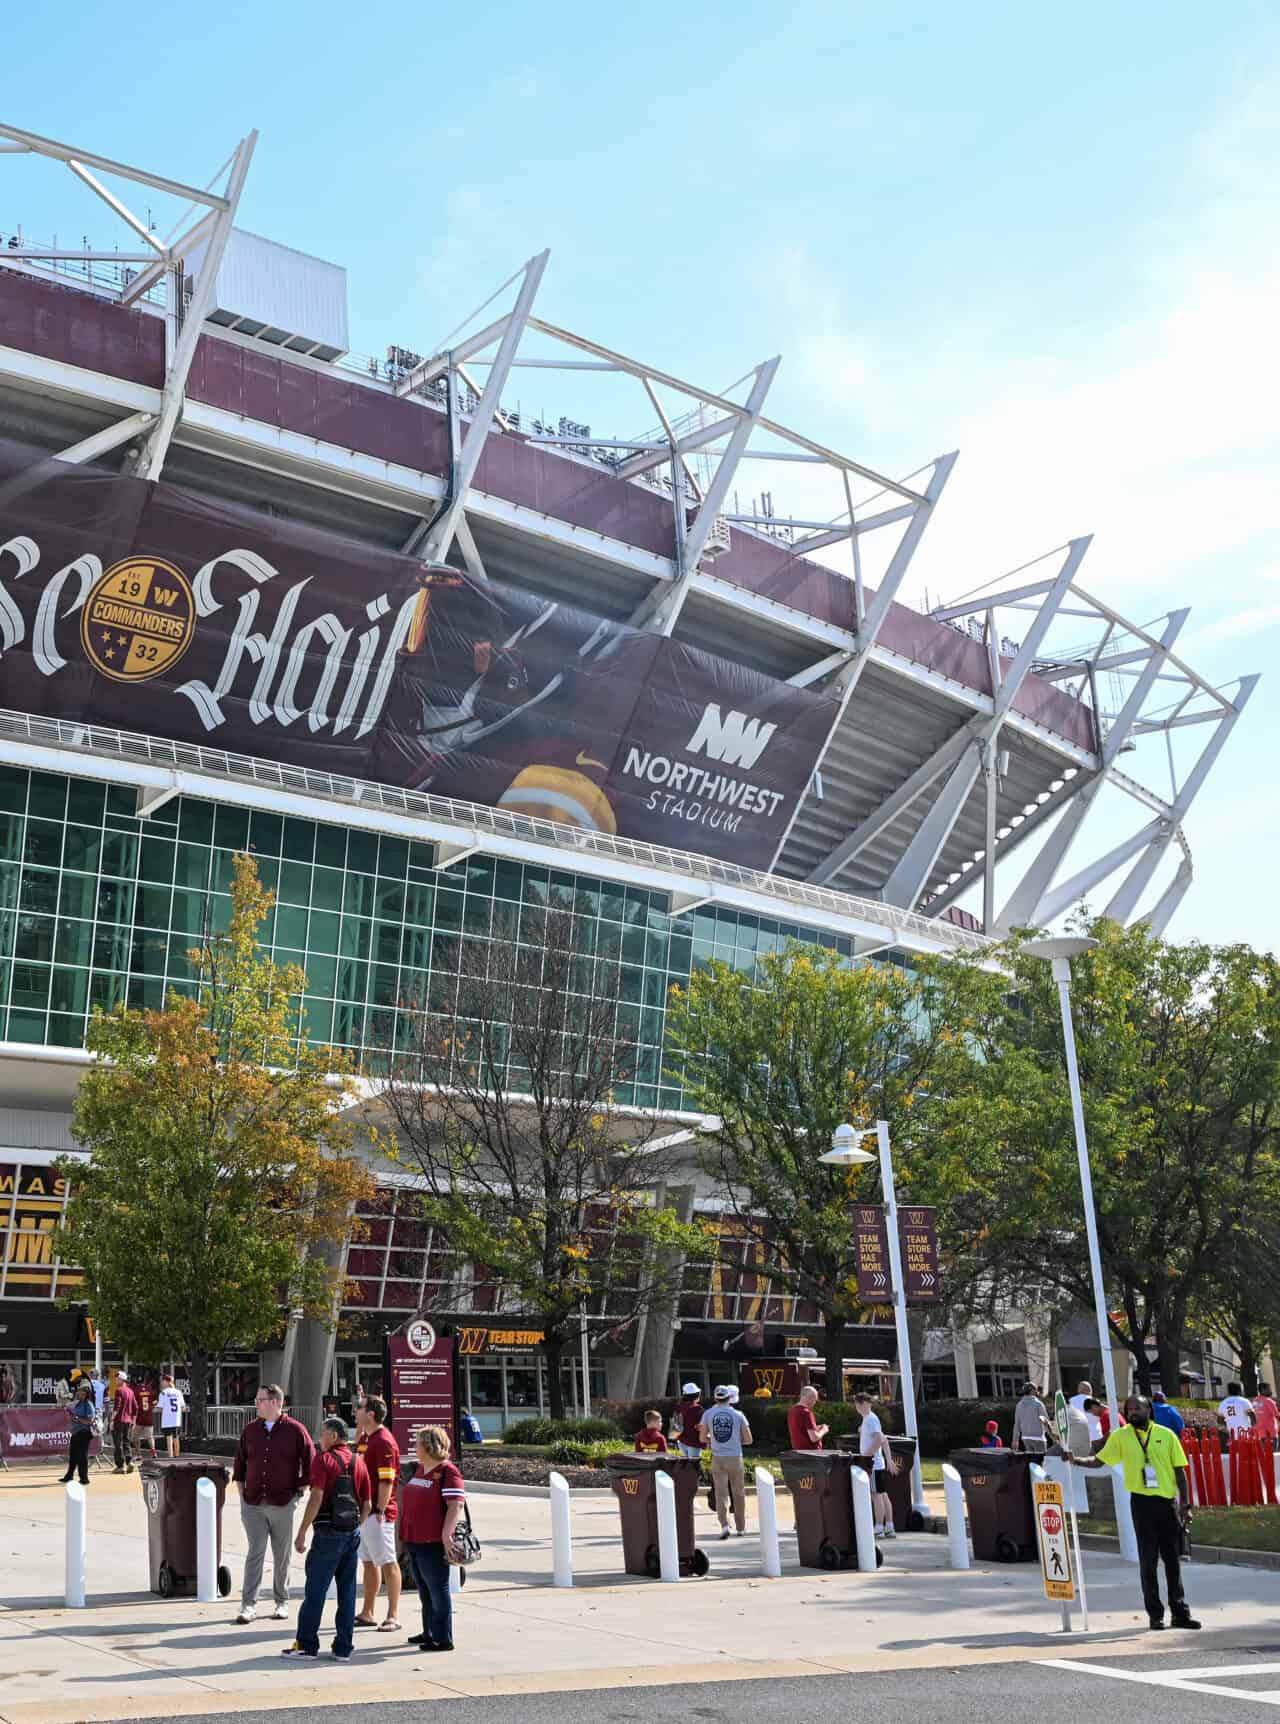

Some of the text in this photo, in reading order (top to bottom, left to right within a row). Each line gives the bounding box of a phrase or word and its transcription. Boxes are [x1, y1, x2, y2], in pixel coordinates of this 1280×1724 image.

[118, 580, 141, 597] 19
[154, 586, 179, 607] W
[93, 601, 185, 637] COMMANDERS
[174, 549, 424, 741] Hail
[135, 644, 158, 661] 32
[623, 748, 784, 816] NORTHWEST
[646, 790, 743, 833] STADIUM
[858, 1234, 879, 1243] TEAM
[906, 1235, 928, 1243] TEAM
[907, 1244, 932, 1253] STORE
[860, 1253, 876, 1262] HAS
[908, 1254, 924, 1262] HAS
[488, 1330, 545, 1345] TEAM STOR
[170, 1398, 178, 1412] 5
[1227, 1405, 1236, 1416] 21
[36, 1432, 72, 1440] NORTH
[1038, 1484, 1057, 1492] STATE
[1041, 1516, 1060, 1527] STOP
